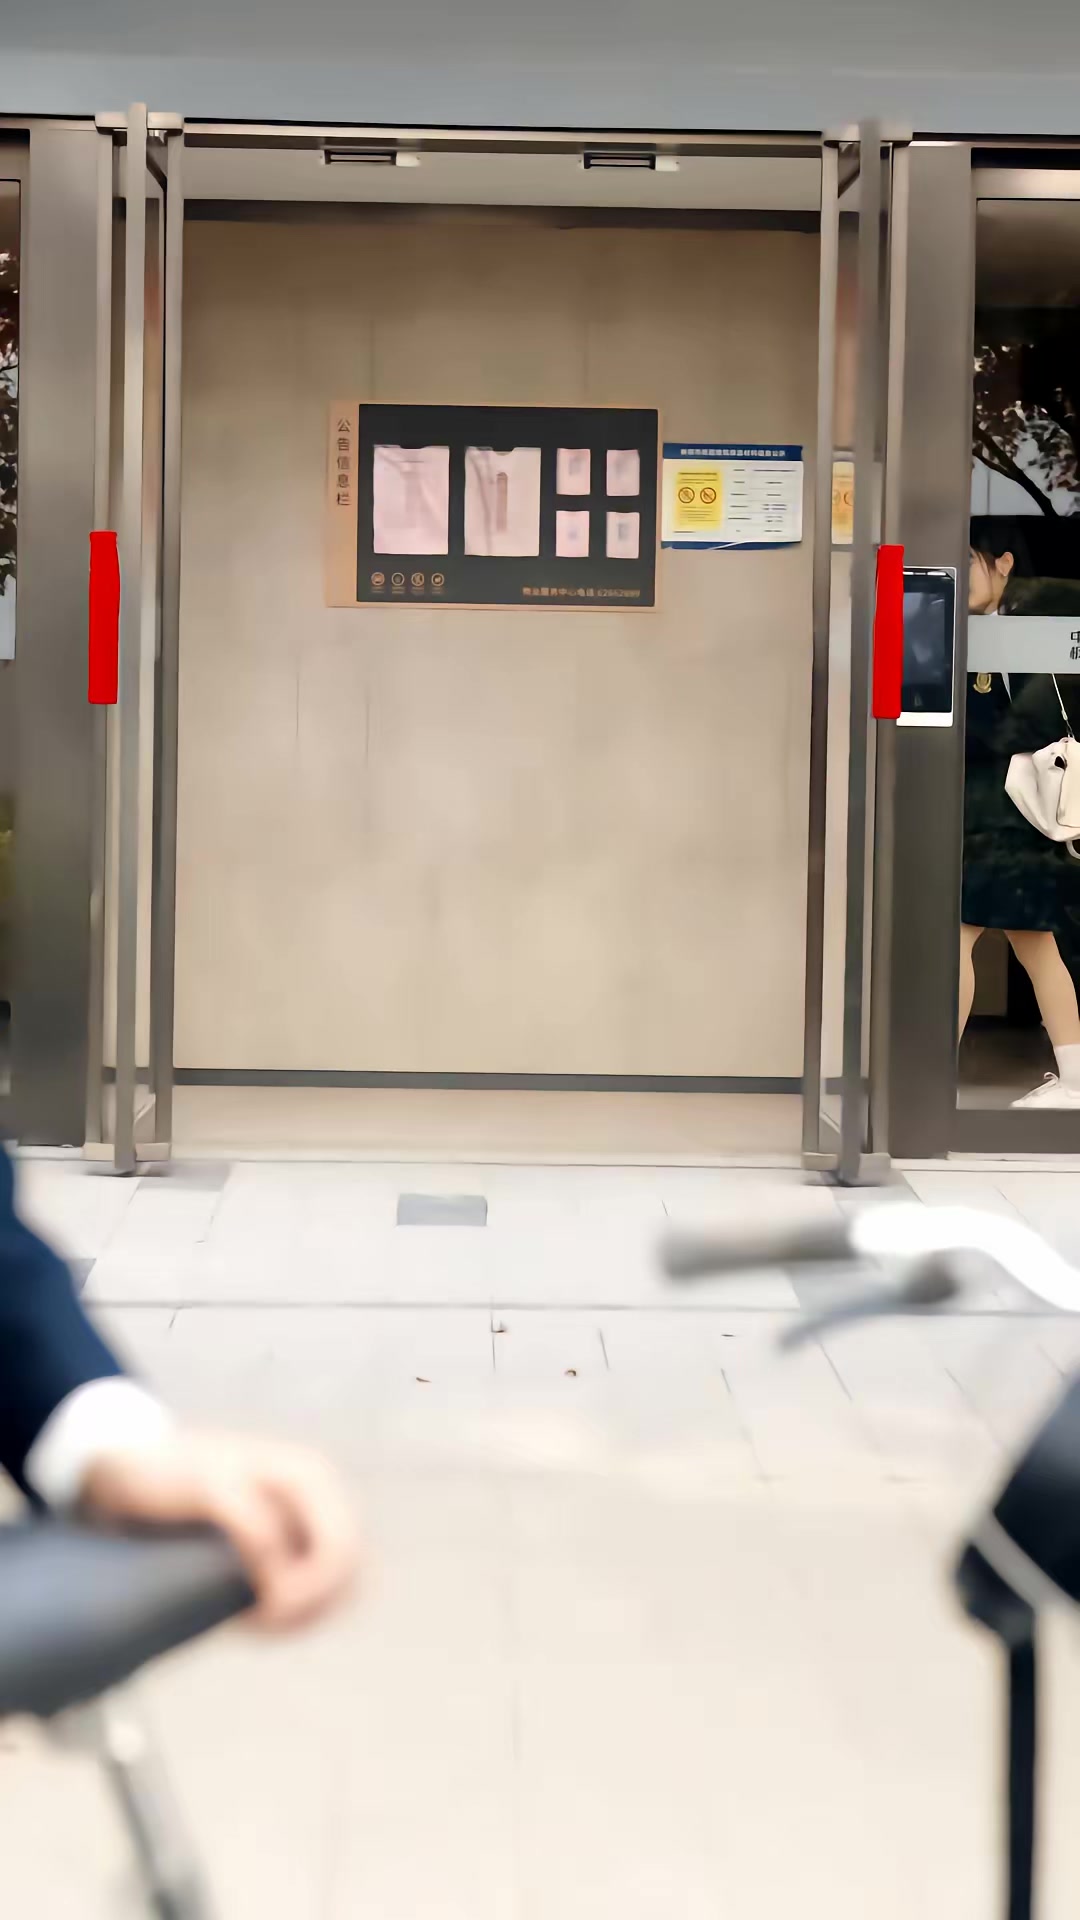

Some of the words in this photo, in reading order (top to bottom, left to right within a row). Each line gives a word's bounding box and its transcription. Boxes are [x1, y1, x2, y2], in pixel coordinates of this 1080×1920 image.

[336, 417, 352, 507] 公告信息栏
